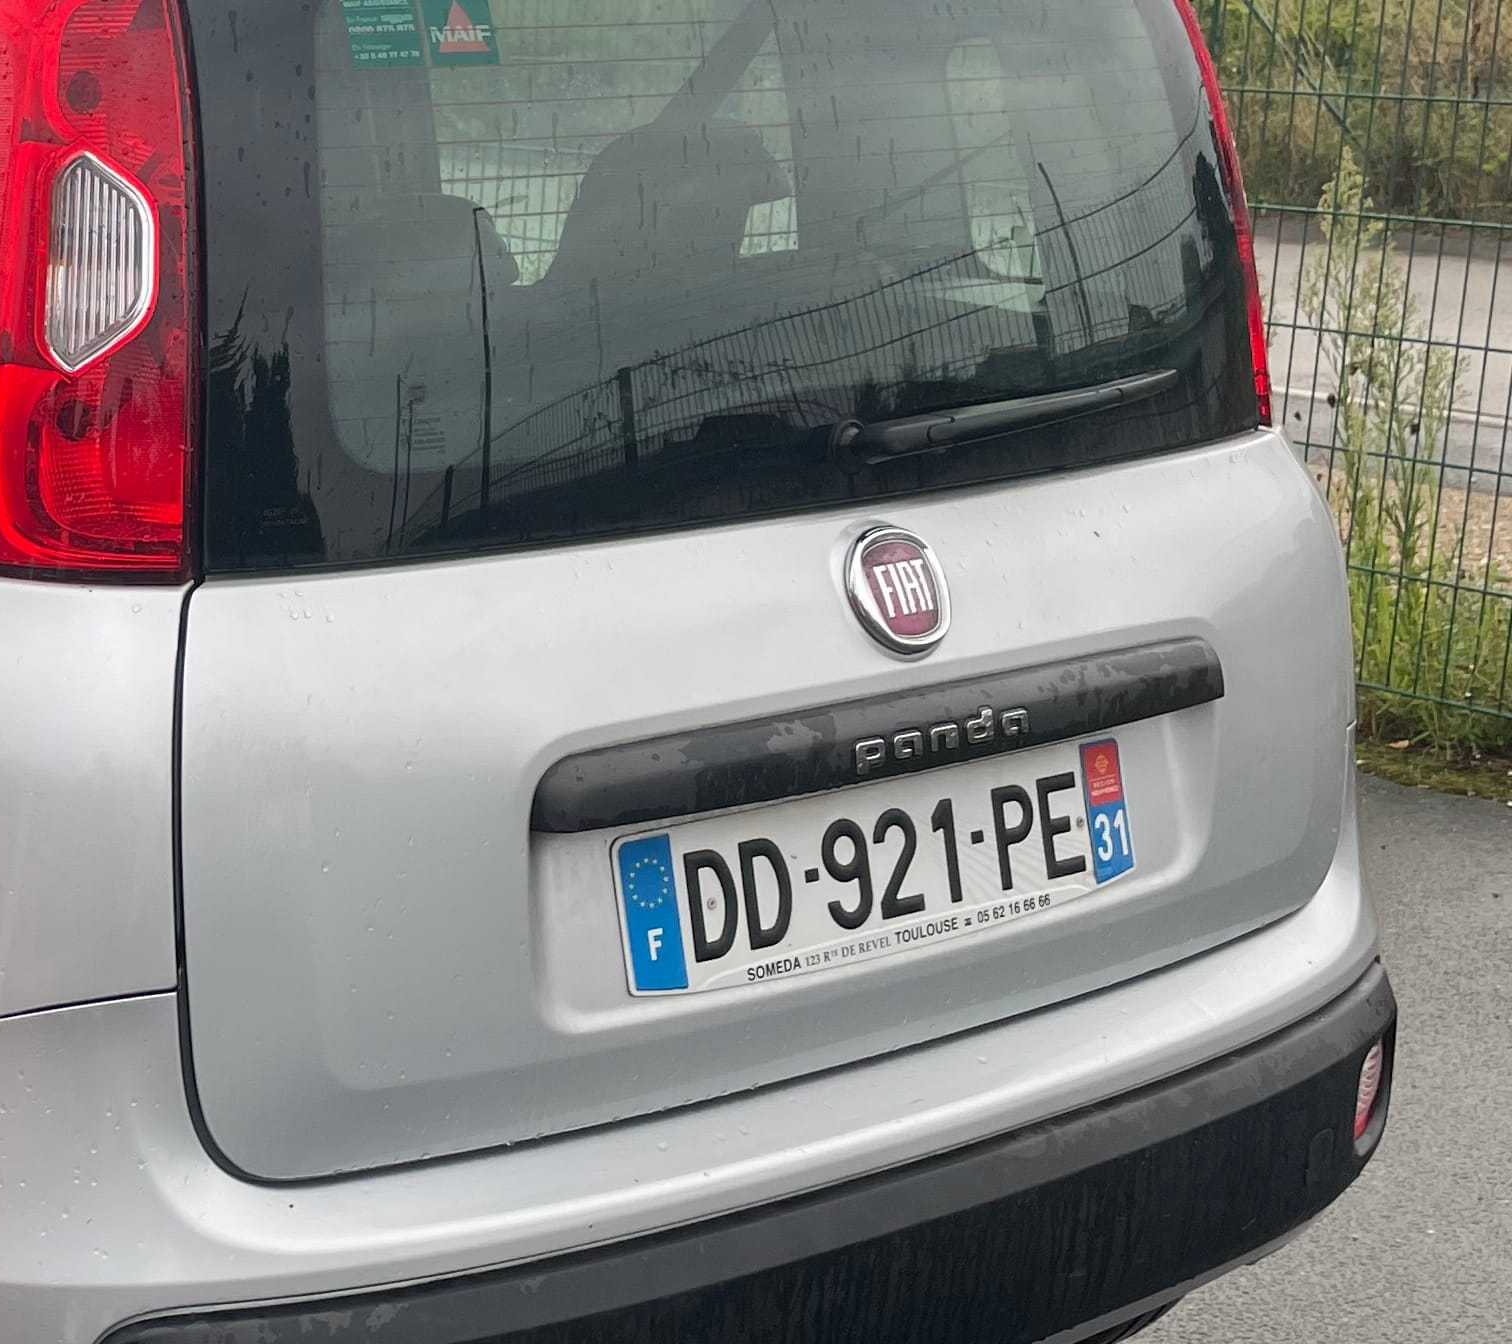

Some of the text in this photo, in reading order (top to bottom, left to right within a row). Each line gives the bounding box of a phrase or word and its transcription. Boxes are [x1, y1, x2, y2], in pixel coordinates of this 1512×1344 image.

[430, 24, 492, 43] MAIF
[872, 559, 934, 618] FIAT
[855, 706, 1029, 776] panda
[647, 771, 1129, 963] F DD-921-PE 31
[746, 956, 802, 981] SOMEDA
[804, 955, 821, 967] 123
[841, 944, 857, 957] DE
[858, 935, 892, 954] REVEL
[894, 917, 959, 944] TOULOUSE
[977, 910, 990, 923] 05
[993, 905, 1005, 919] 62
[1009, 901, 1021, 915] 16
